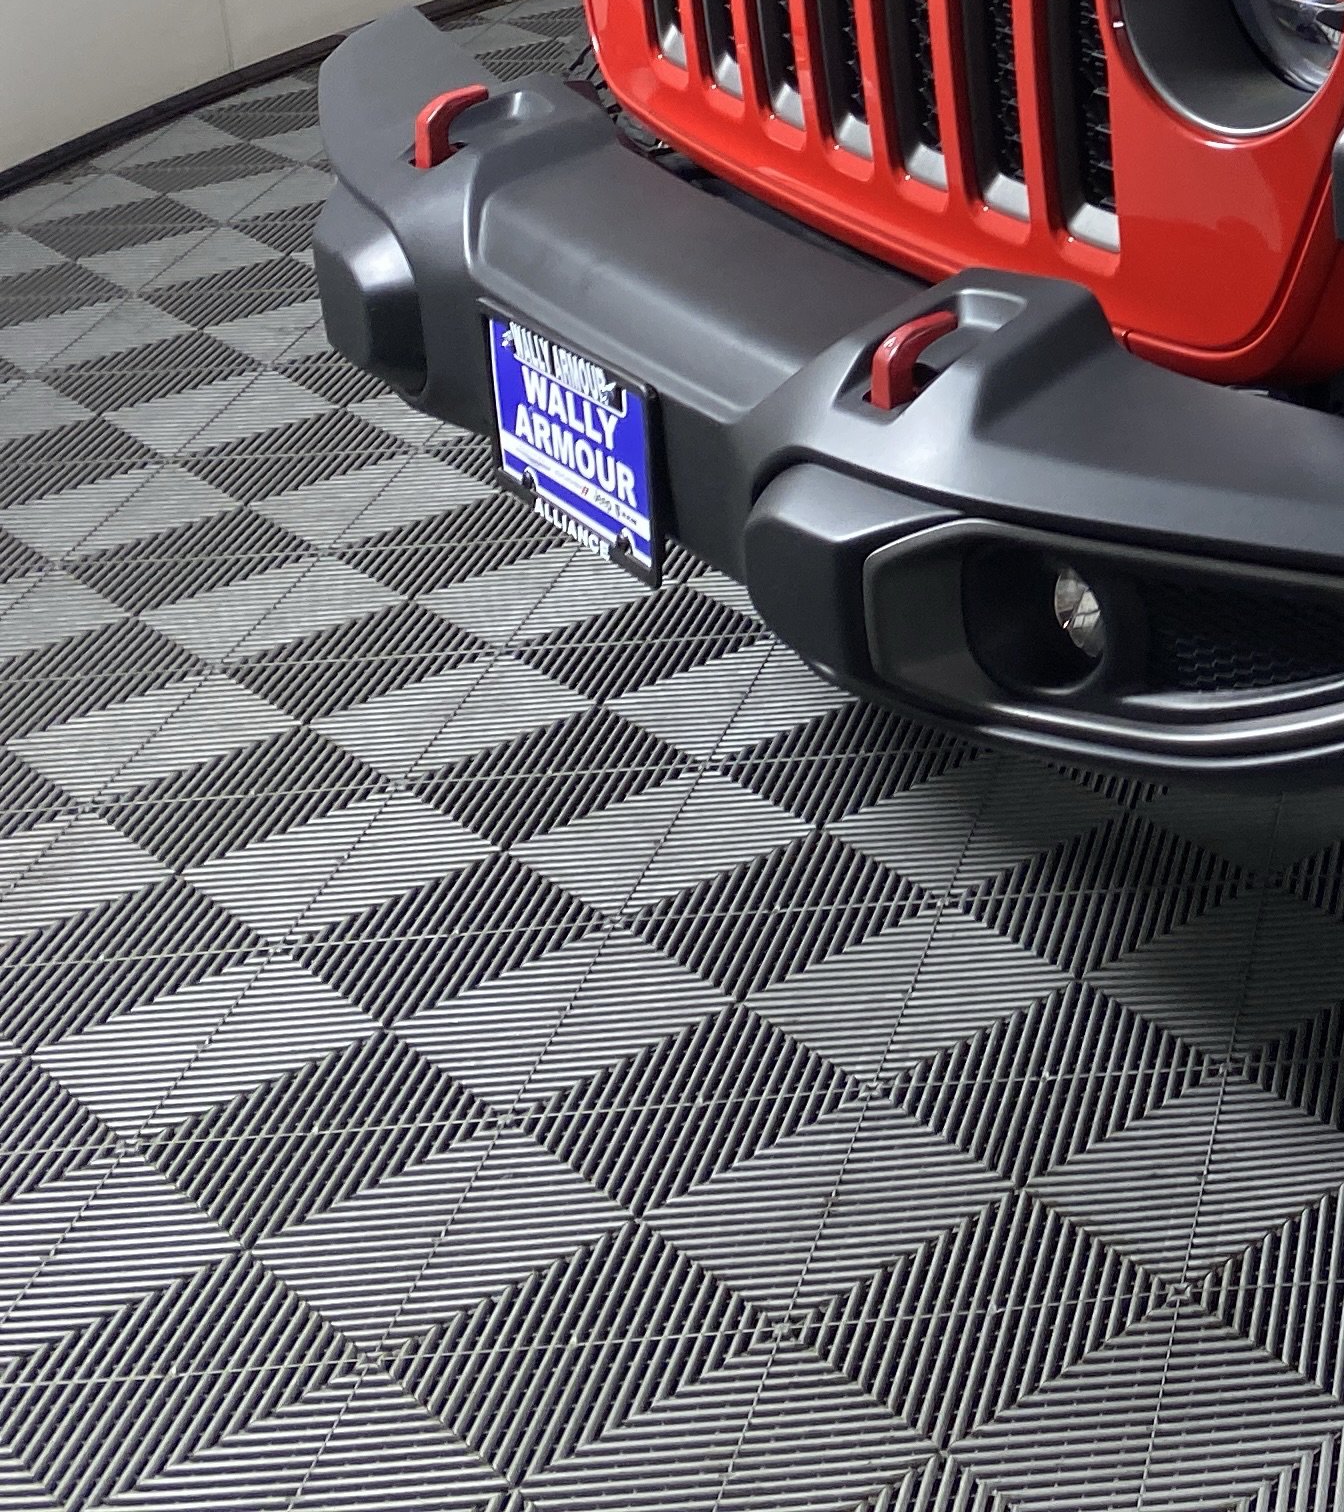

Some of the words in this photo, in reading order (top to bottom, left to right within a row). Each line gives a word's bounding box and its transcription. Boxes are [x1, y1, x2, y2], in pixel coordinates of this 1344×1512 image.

[509, 321, 550, 374] WALLY
[552, 344, 609, 403] ARMOUR
[521, 365, 619, 451] WALLY
[514, 403, 638, 509] ARMOUR
[534, 496, 612, 562] ALLIANCE
